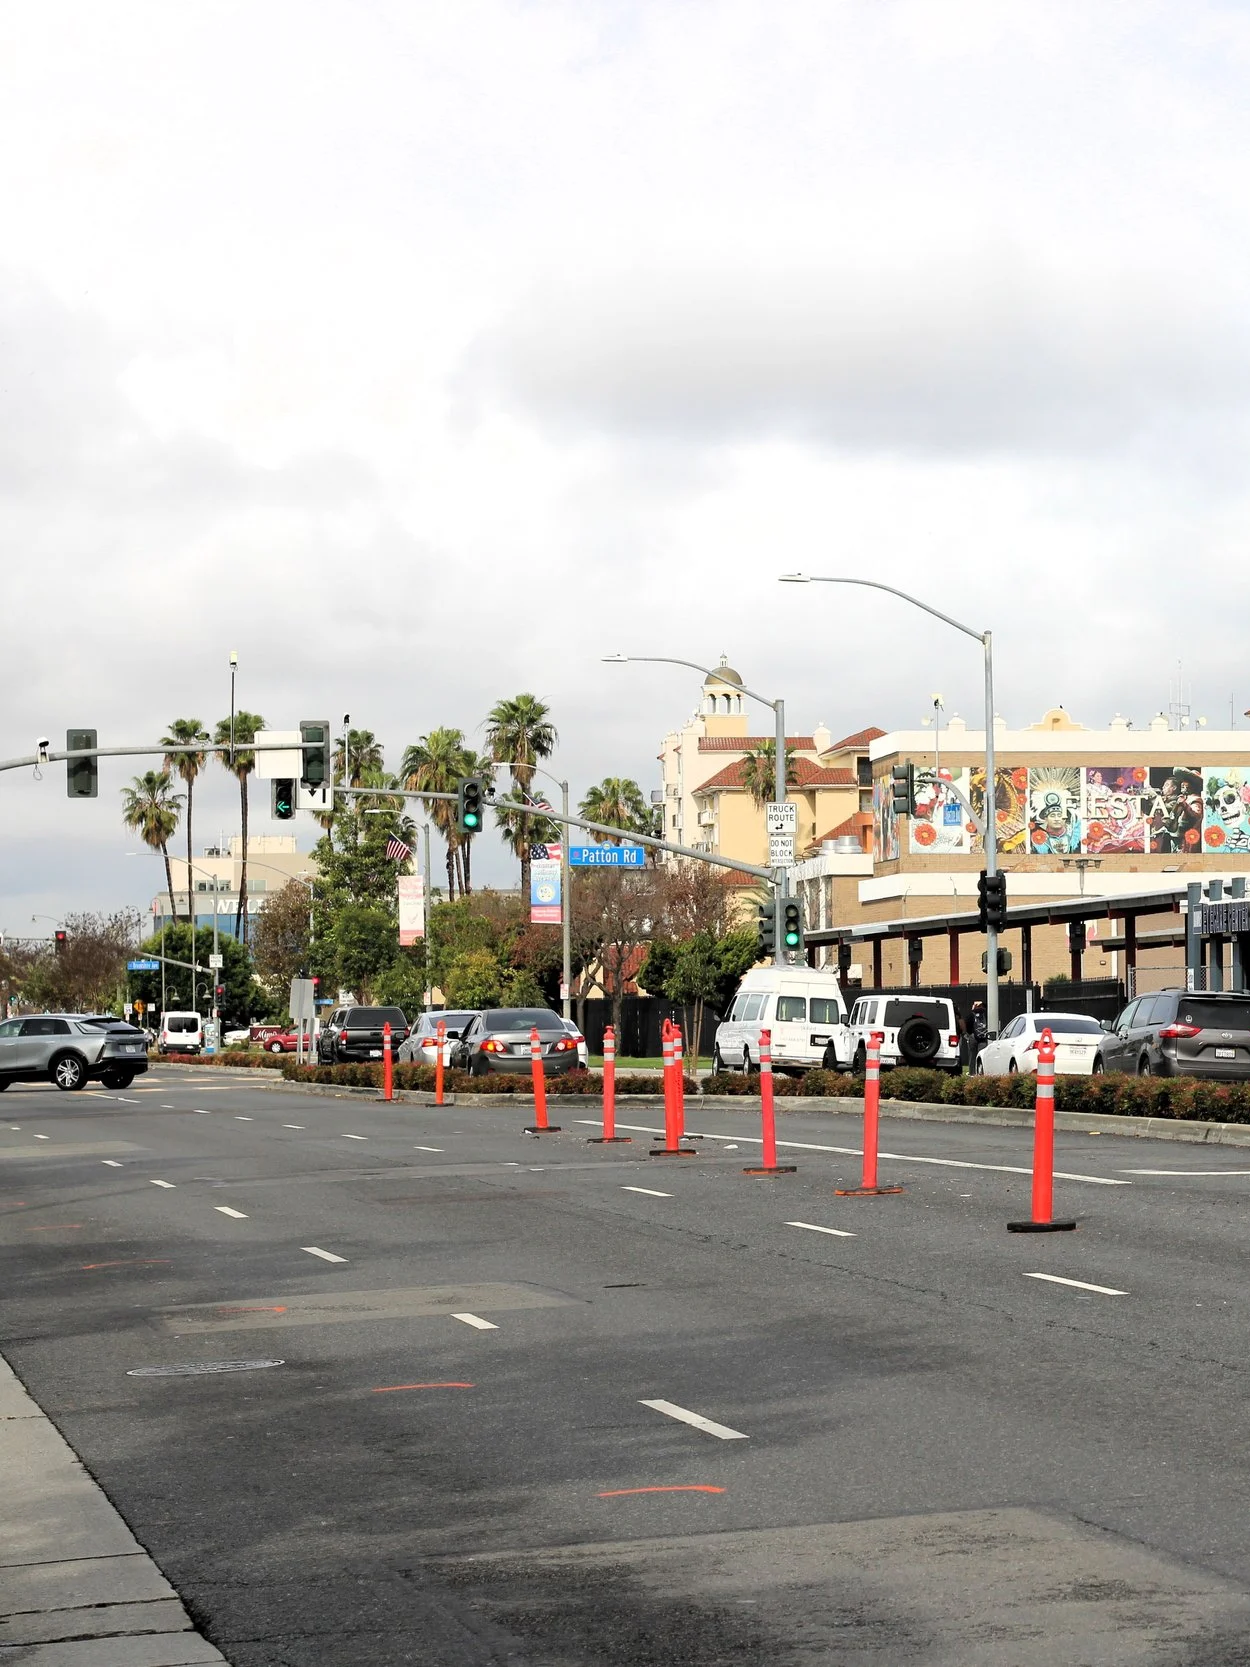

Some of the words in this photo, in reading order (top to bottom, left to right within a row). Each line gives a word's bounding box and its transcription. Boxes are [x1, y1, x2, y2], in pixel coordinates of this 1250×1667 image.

[1061, 795, 1171, 819] FIESTA
[770, 839, 779, 847] DO
[781, 839, 792, 847] NOT
[582, 849, 618, 863] Patton
[623, 849, 637, 863] Rd
